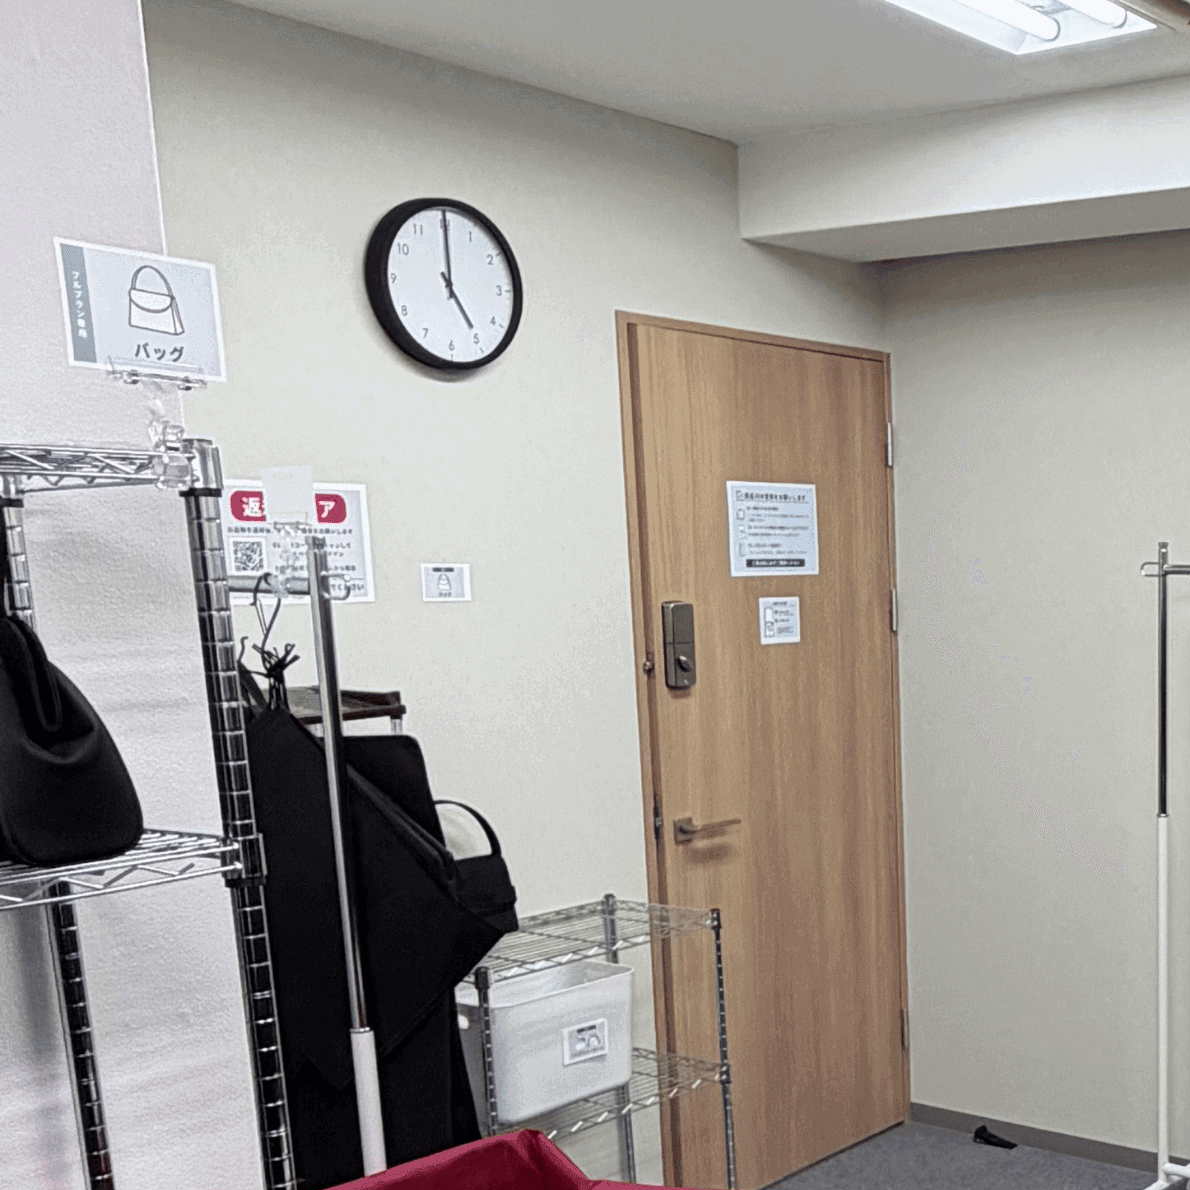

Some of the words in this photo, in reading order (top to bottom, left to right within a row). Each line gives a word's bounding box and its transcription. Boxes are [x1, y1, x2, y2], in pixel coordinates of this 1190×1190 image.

[413, 223, 423, 235] 11
[397, 242, 409, 256] 10
[487, 254, 494, 265] 2
[390, 272, 397, 284] 9
[496, 285, 502, 296] 3
[401, 305, 408, 317] 8
[489, 315, 496, 326] 4
[422, 328, 429, 339] 7
[473, 333, 480, 344] 5
[448, 340, 455, 351] 6
[135, 342, 184, 363] バッグ
